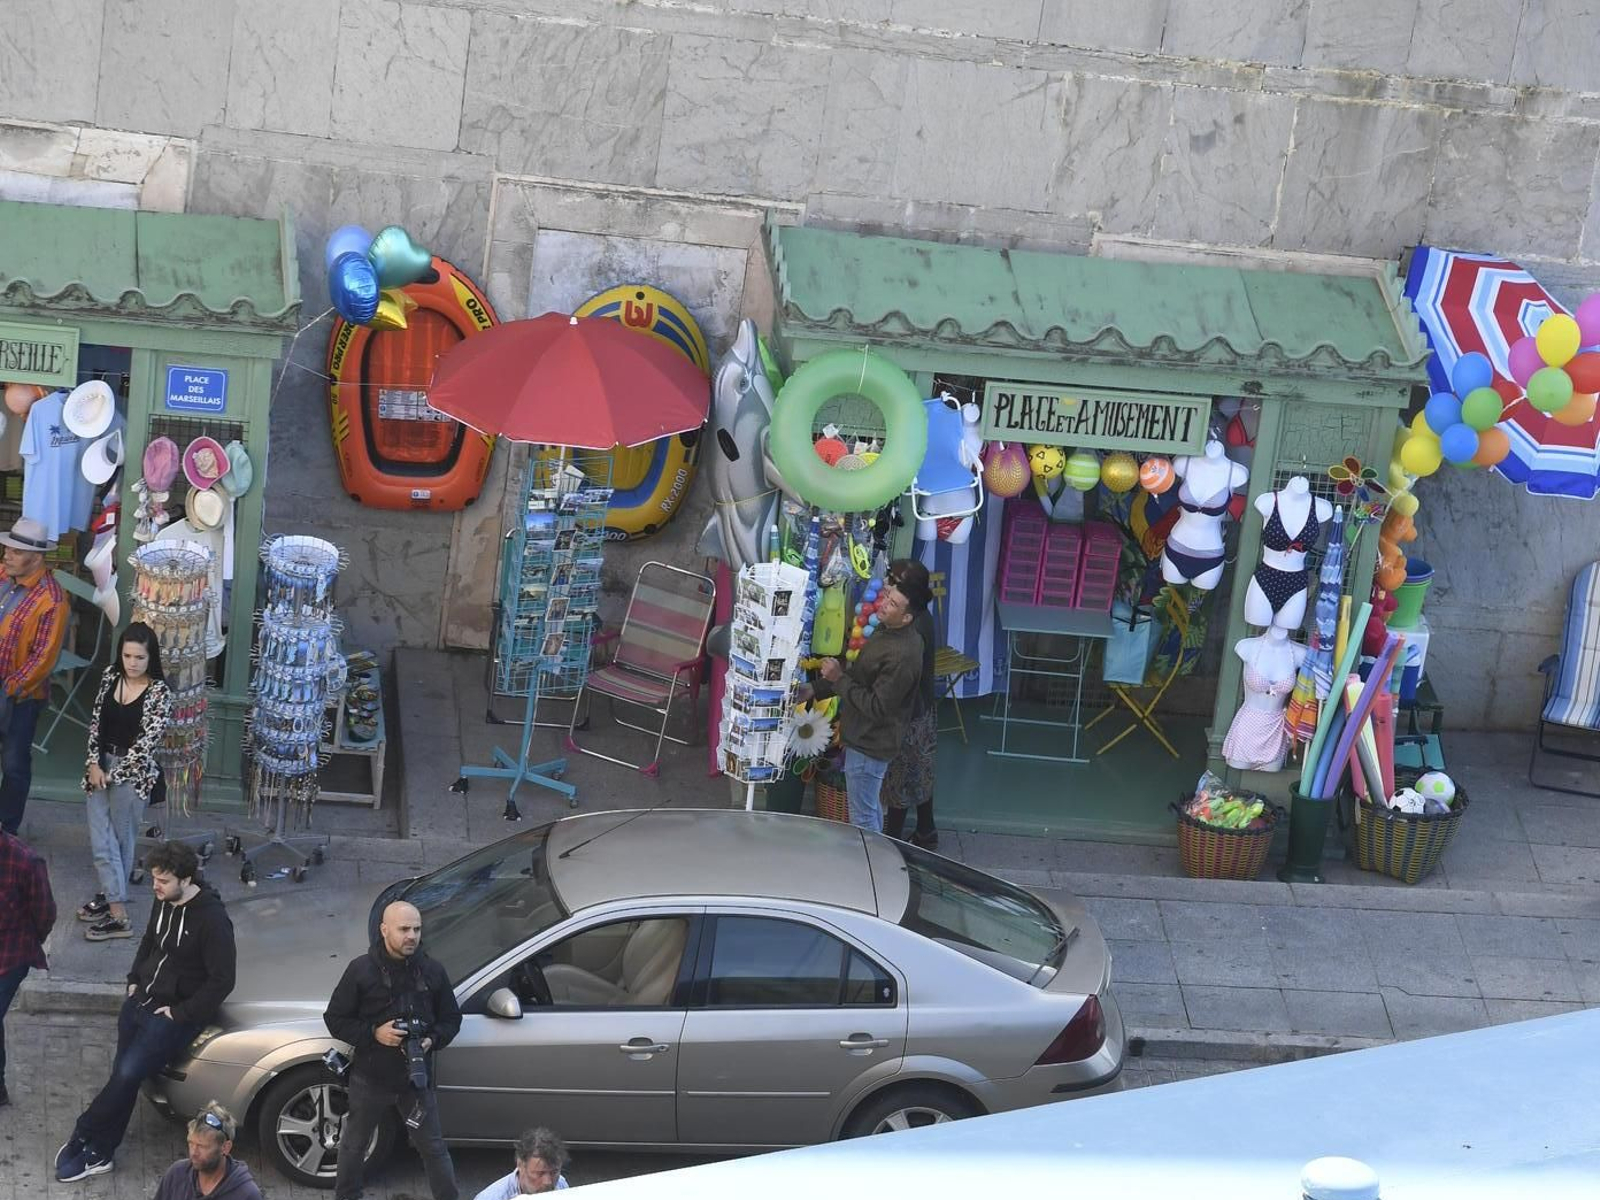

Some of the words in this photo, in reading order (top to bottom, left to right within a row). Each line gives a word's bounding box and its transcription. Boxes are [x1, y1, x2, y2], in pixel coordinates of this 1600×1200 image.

[184, 375, 210, 385] PLACE
[188, 385, 204, 394] DES
[170, 394, 221, 406] MARSEILLAIS
[1074, 398, 1198, 442] AMUSEMENT
